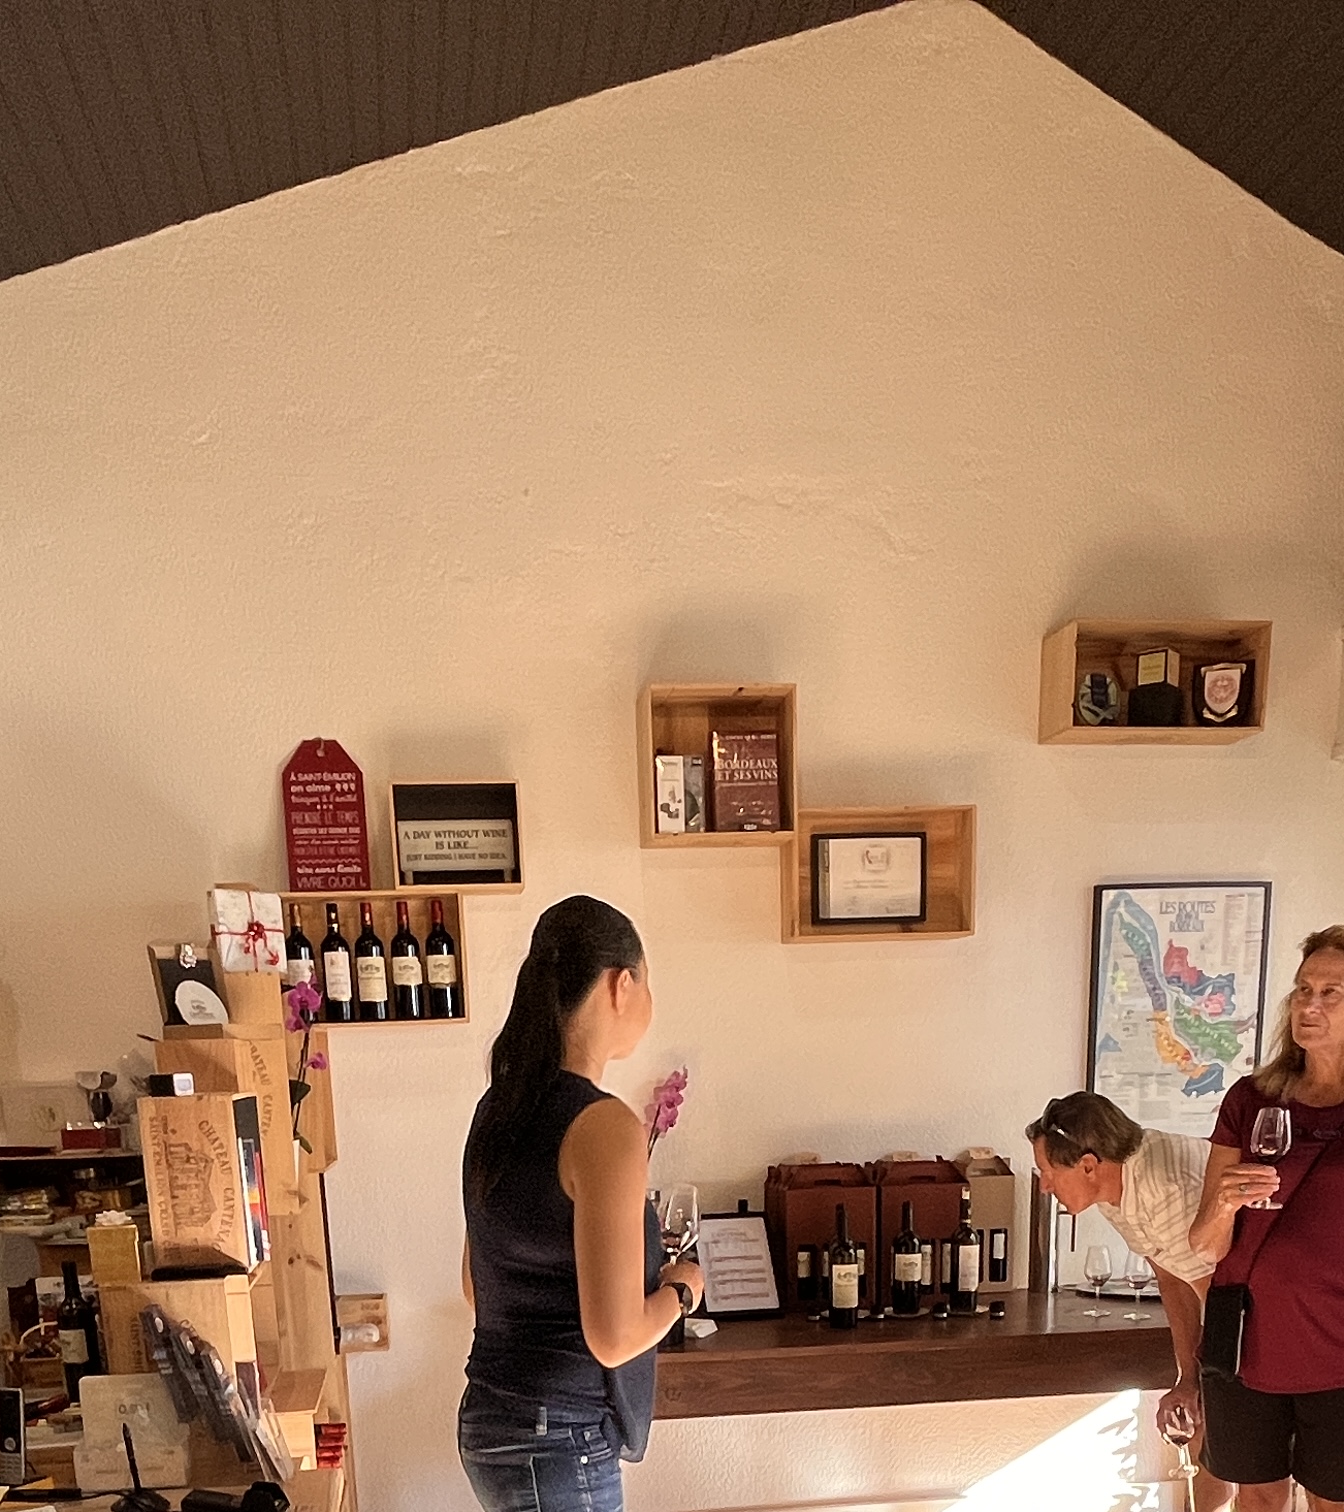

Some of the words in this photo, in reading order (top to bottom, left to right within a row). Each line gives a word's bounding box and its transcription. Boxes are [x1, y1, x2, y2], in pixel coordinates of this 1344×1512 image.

[717, 758, 778, 770] BORDEAUX
[717, 770, 732, 780] ET
[734, 770, 751, 780] SES
[753, 769, 778, 780] VINS
[306, 783, 331, 792] aime
[404, 831, 410, 840] A
[413, 830, 431, 839] DAY
[434, 829, 480, 839] WITHOUT
[482, 829, 508, 838] WINE
[435, 841, 444, 850] IS
[297, 876, 325, 889] VIVRE
[328, 876, 355, 888] QUOI
[1159, 901, 1177, 914] LES
[1178, 901, 1216, 914] ROUTES
[198, 1119, 233, 1175] CHATEAU
[212, 1187, 236, 1252] CANTENAC
